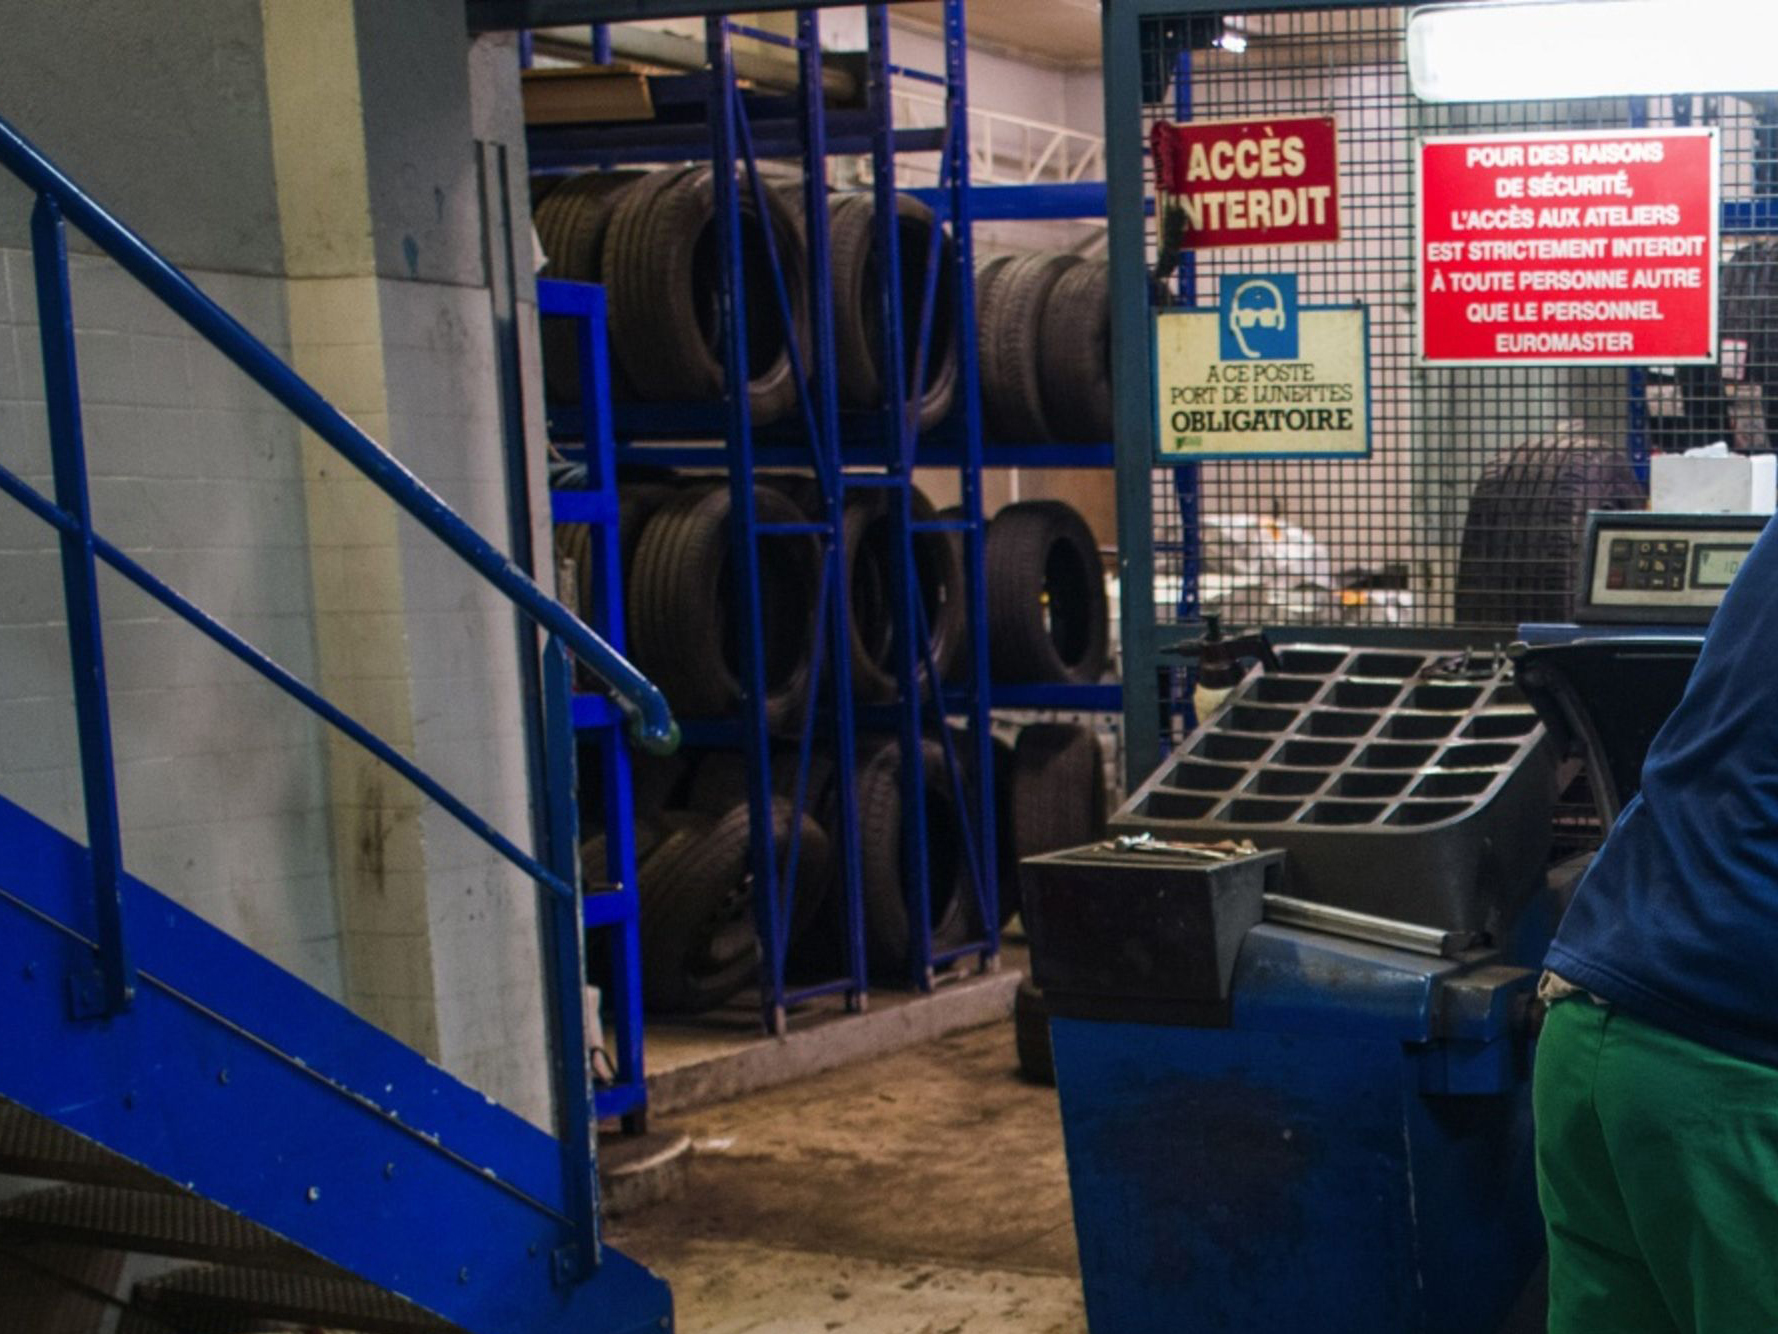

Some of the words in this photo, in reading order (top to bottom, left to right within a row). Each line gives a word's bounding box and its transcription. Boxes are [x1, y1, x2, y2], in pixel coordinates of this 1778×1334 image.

[1187, 126, 1307, 182] ACCÈS
[1466, 146, 1524, 168] POUR
[1528, 145, 1570, 166] DES
[1573, 142, 1664, 165] RAISONS
[1495, 177, 1524, 198] DE
[1528, 170, 1634, 198] SÉCURITÉ,
[1451, 203, 1535, 231] L'ACCÈS
[1538, 207, 1580, 228] AUX
[1584, 204, 1680, 227] ATELIERS
[1427, 241, 1465, 261] EST
[1468, 238, 1607, 260] STRICTEMENT
[1611, 236, 1706, 257] INTERDIT
[1430, 269, 1445, 292] À
[1449, 271, 1515, 292] TOUTE
[1519, 270, 1629, 291] PERSONNE
[1632, 267, 1701, 289] AUTRE
[1466, 303, 1509, 323] QUE
[1513, 302, 1538, 322] LE
[1542, 300, 1664, 321] PERSONNEL
[1495, 331, 1634, 353] EUROMASTER
[1206, 365, 1221, 383] A
[1223, 364, 1250, 383] CE
[1253, 363, 1315, 383] POSTE
[1170, 386, 1218, 405] PORT
[1222, 385, 1248, 404] DE
[1253, 384, 1353, 404] LUNETTES
[1170, 408, 1353, 433] OBLIGATOIRE
